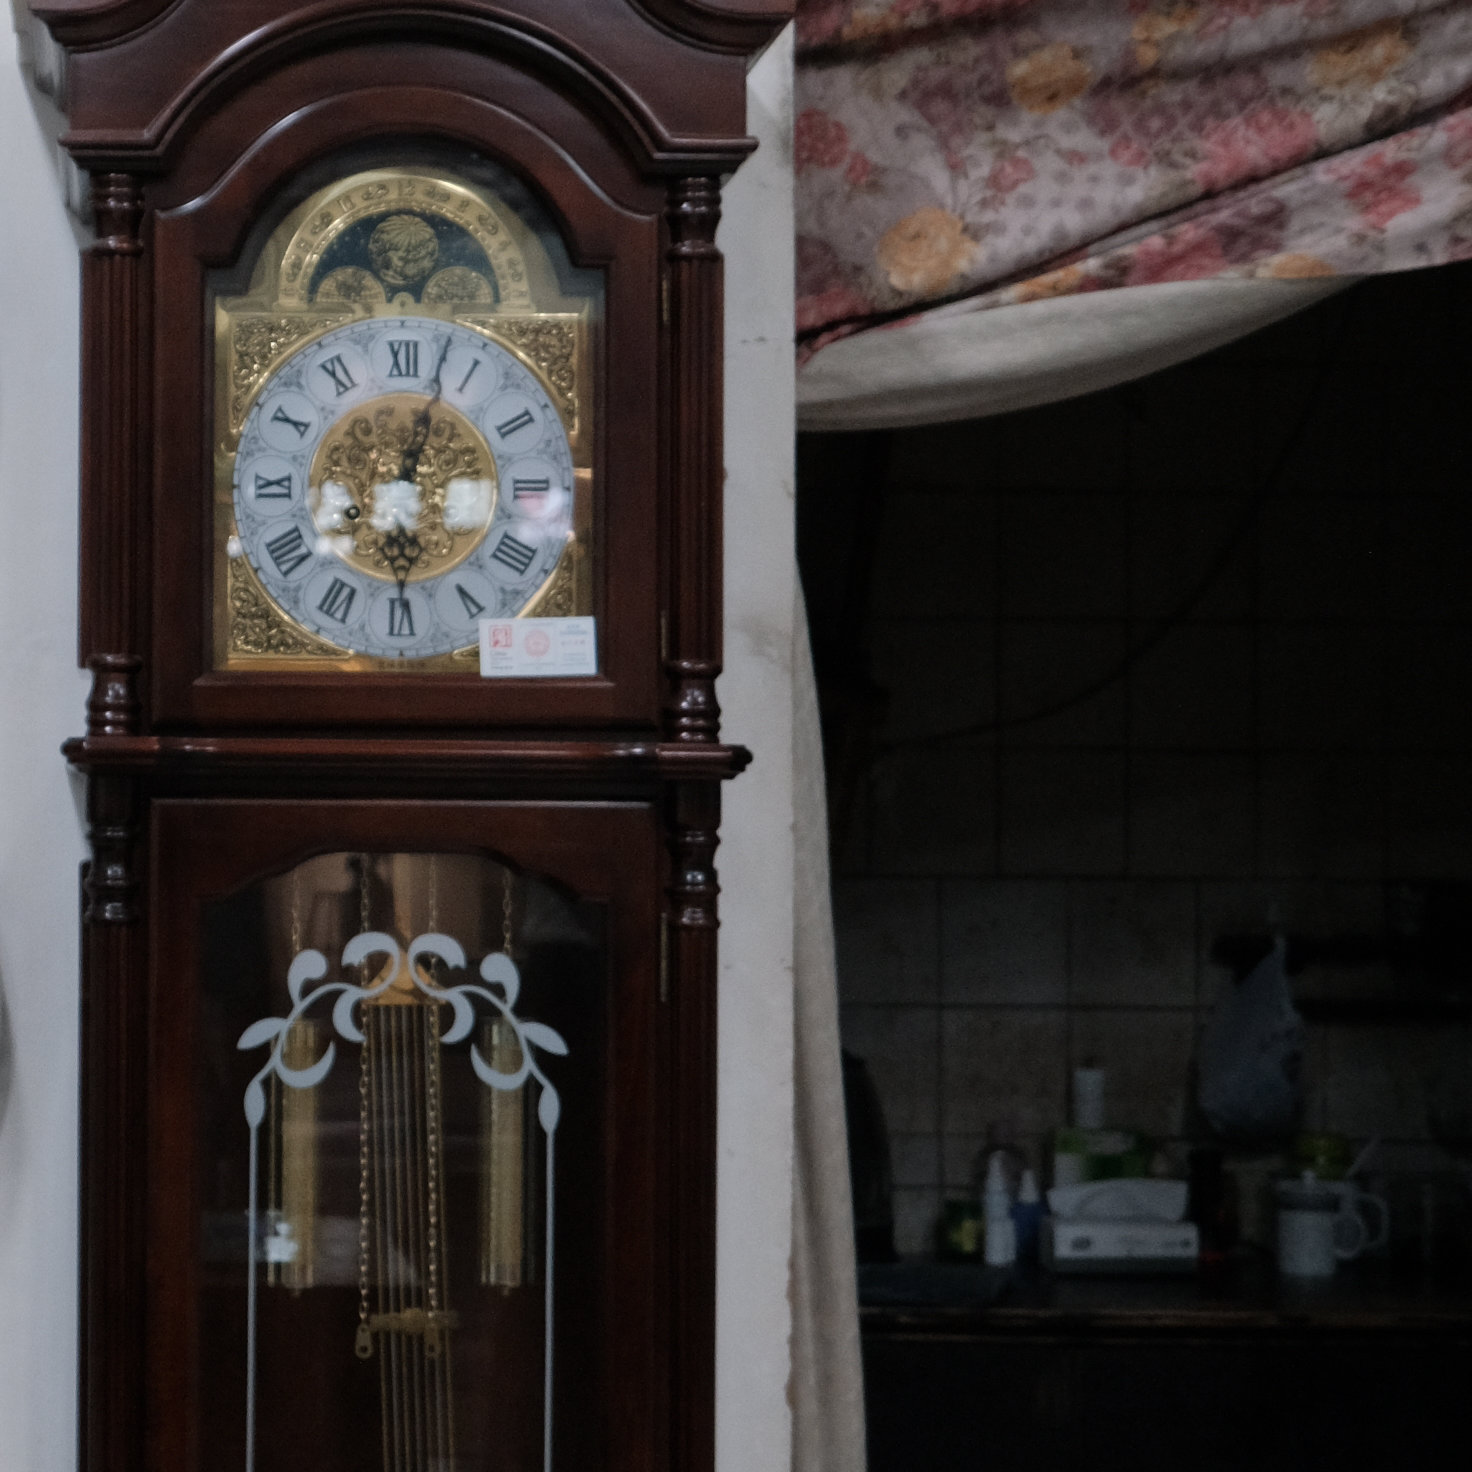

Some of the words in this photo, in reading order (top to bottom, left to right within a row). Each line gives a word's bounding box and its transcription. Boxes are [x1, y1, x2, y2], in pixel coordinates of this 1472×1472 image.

[321, 353, 359, 397] XI
[388, 339, 420, 379] XII
[458, 359, 481, 394] I
[272, 406, 312, 439] X
[498, 408, 535, 439] II
[255, 473, 293, 500] IX
[513, 477, 550, 501] III
[266, 527, 313, 578] VIII
[317, 578, 359, 625] VII
[388, 597, 417, 638] VI
[455, 583, 486, 618] V
